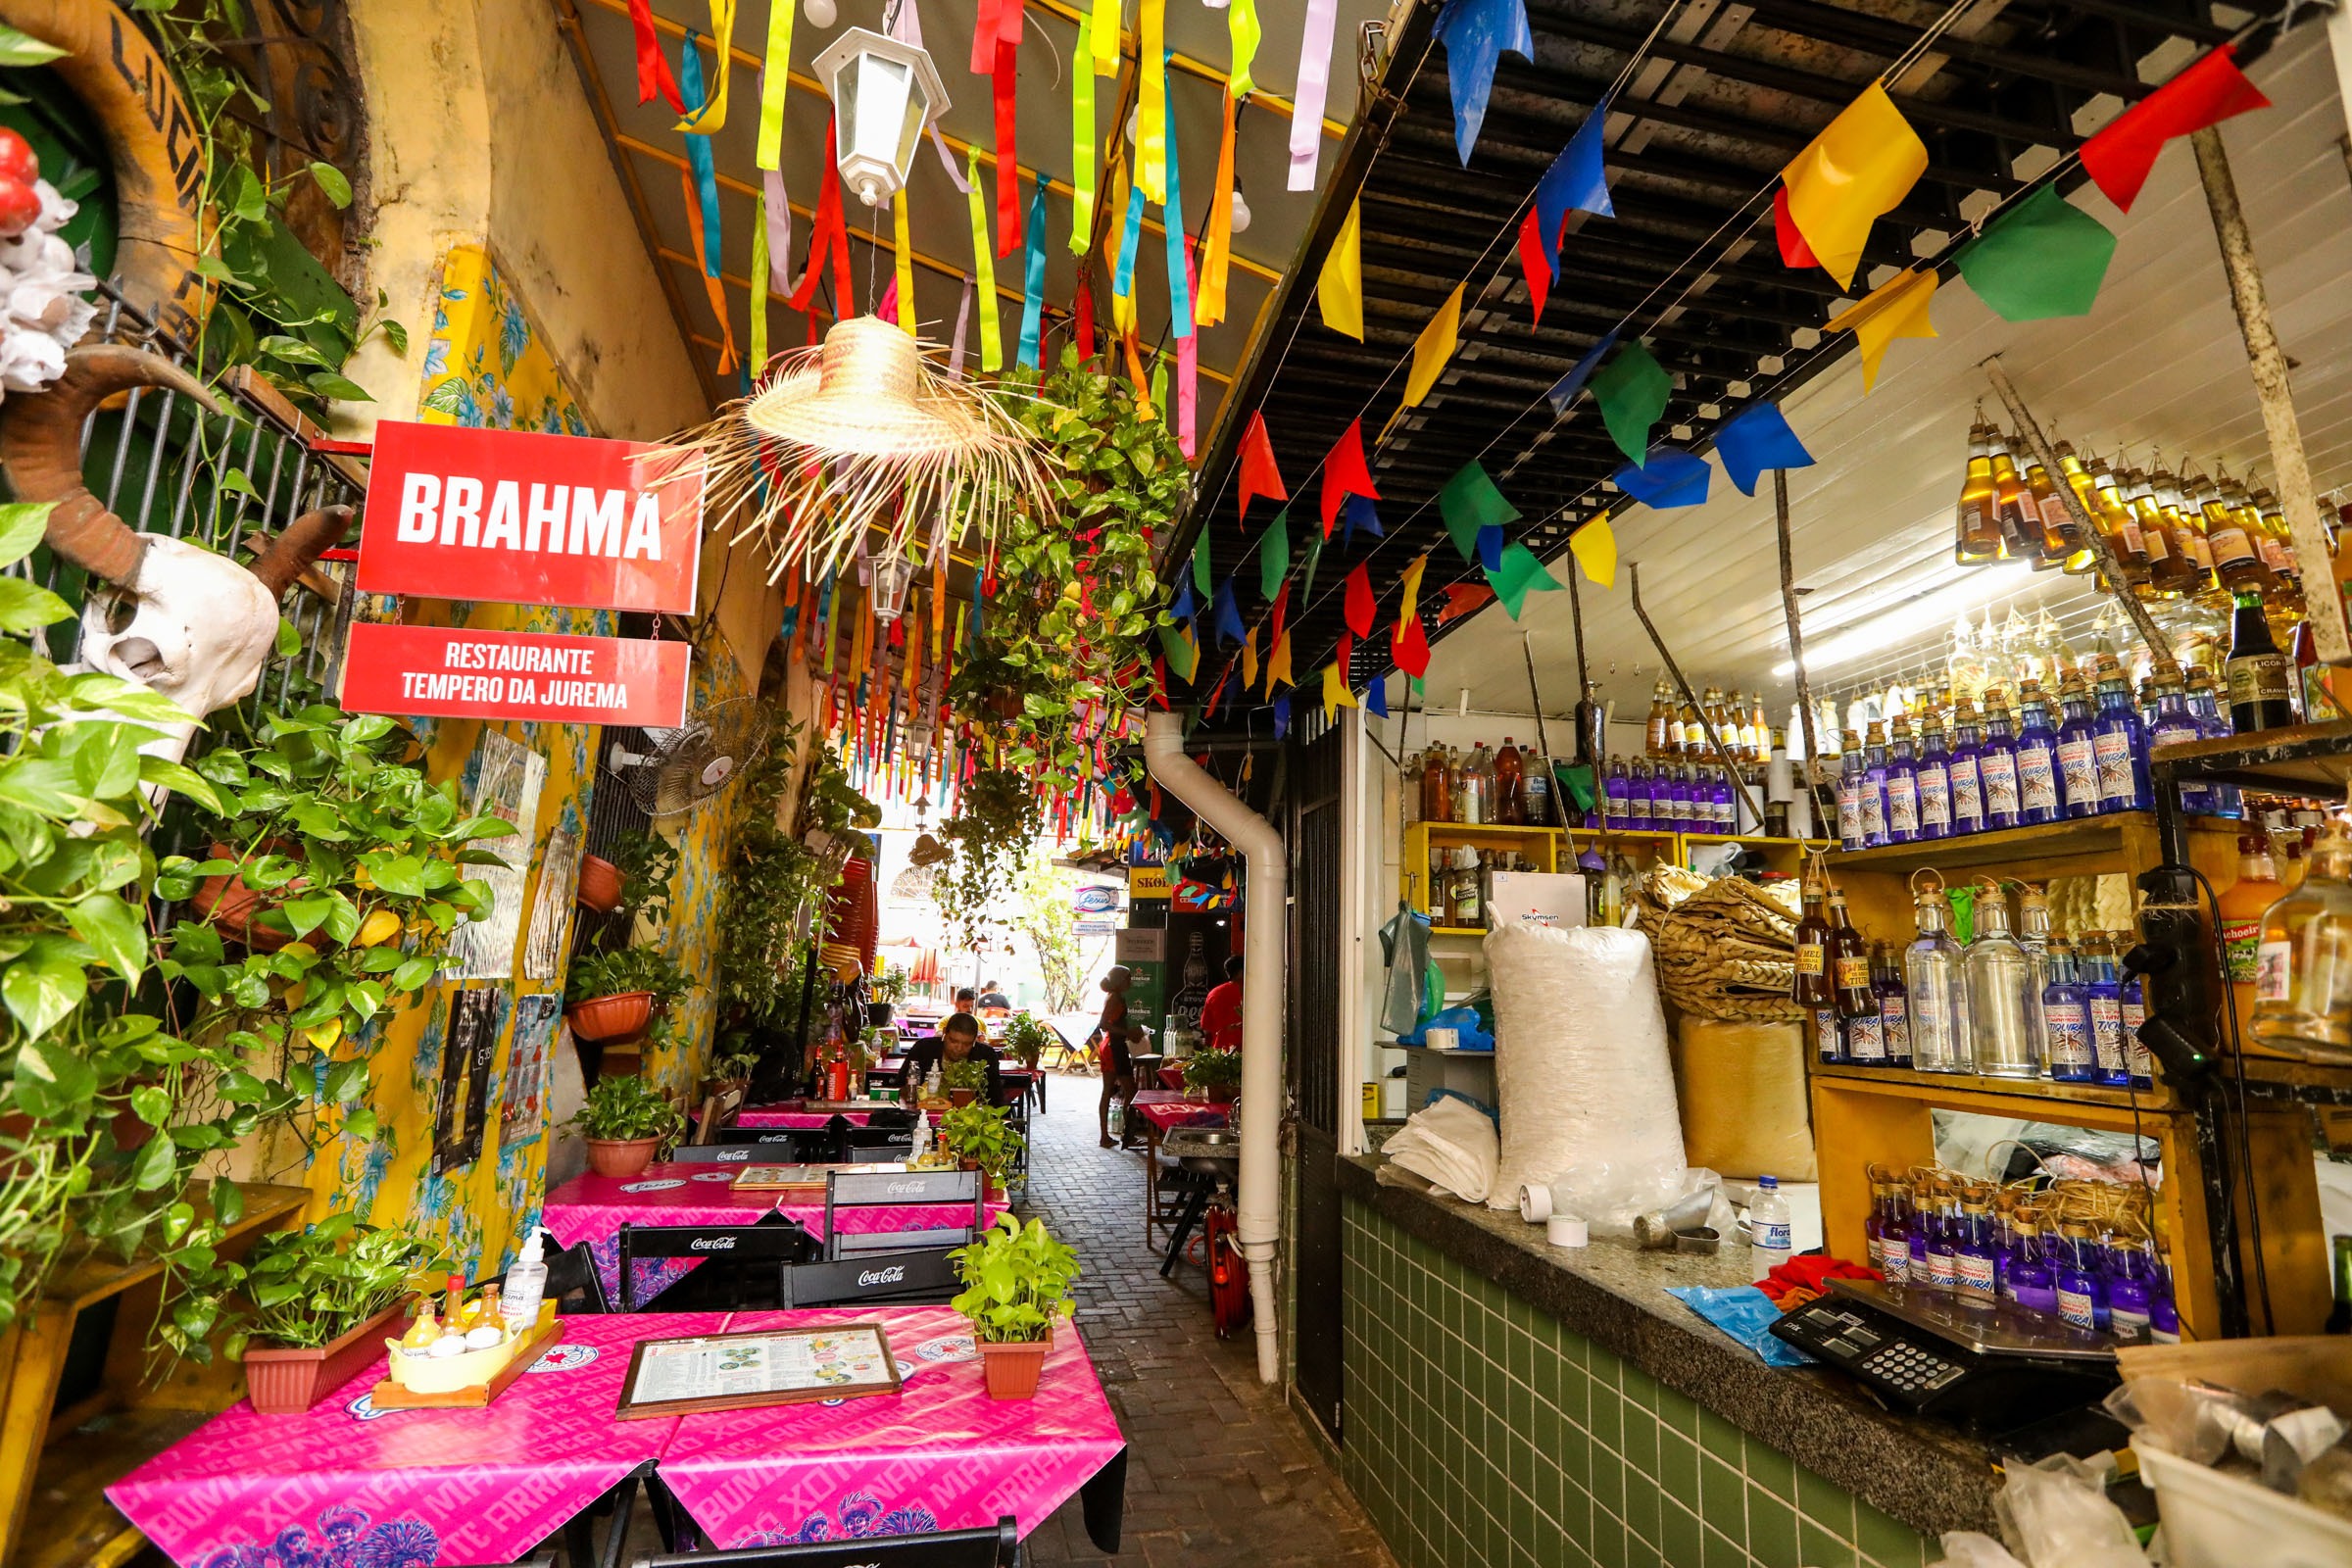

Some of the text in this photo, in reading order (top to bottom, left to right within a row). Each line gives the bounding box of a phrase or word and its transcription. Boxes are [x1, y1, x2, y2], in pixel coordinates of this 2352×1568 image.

[396, 471, 663, 562] BRAHMA
[444, 641, 595, 676] RESTAURANTE
[402, 671, 627, 710] TEMPERO DA JUREMA
[1521, 912, 1559, 922] Skymsen
[2048, 1022, 2084, 1033] TIQUIRA
[759, 1134, 788, 1144] Coca-Cola
[716, 1150, 750, 1161] Coca-Cola
[887, 1180, 926, 1194] Coca-Cola
[690, 1234, 737, 1250] Coca-Cola
[858, 1265, 906, 1287] Coca-Cola
